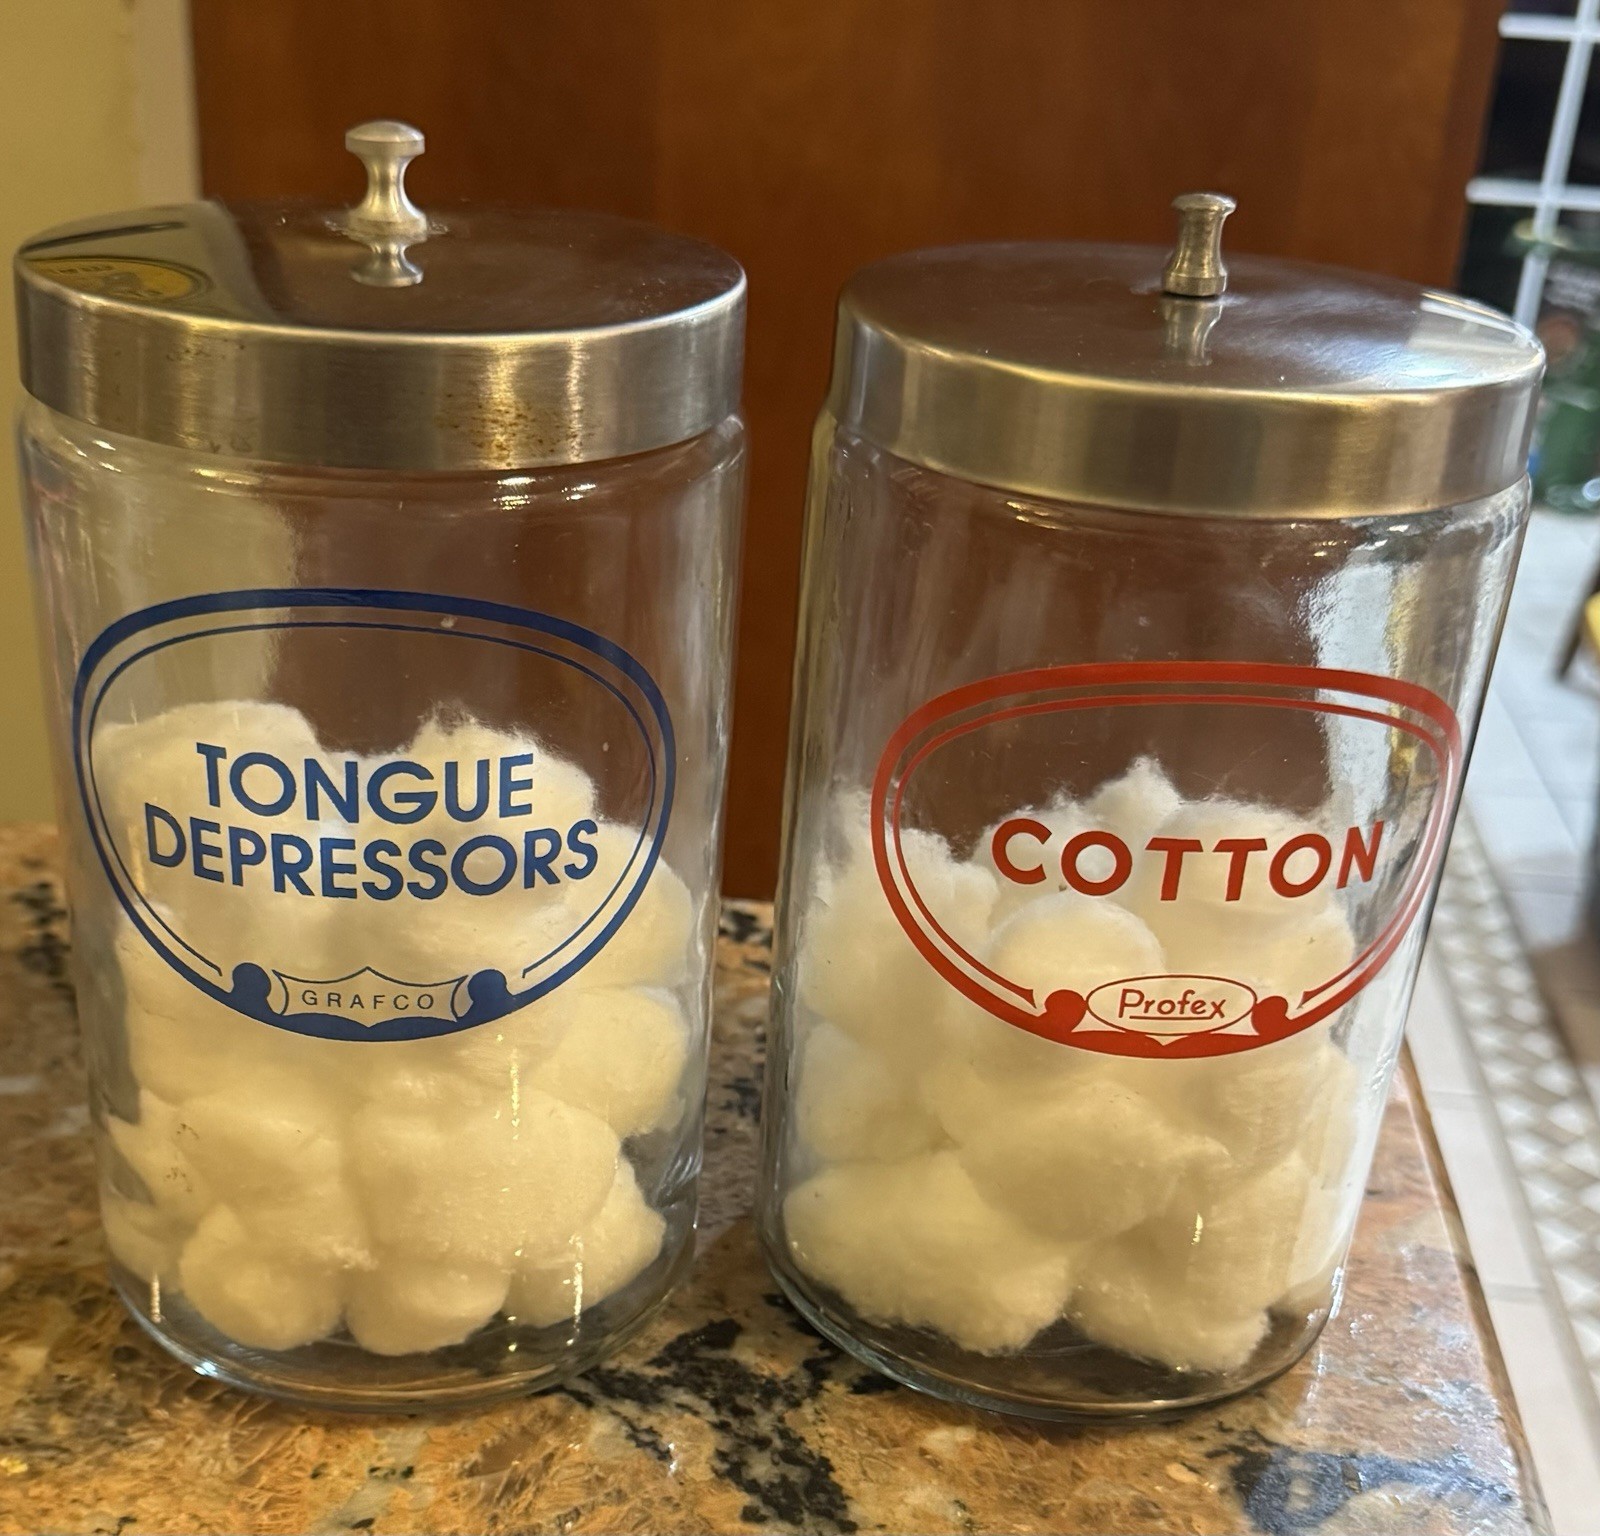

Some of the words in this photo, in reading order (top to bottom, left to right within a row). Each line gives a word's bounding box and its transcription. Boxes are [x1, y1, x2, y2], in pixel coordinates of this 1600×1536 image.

[196, 742, 534, 824] TONGUE
[145, 803, 598, 901] DEPRESSORS
[991, 818, 1385, 901] COTTON
[301, 989, 434, 1010] GRAFCO
[1118, 988, 1227, 1020] Profex
